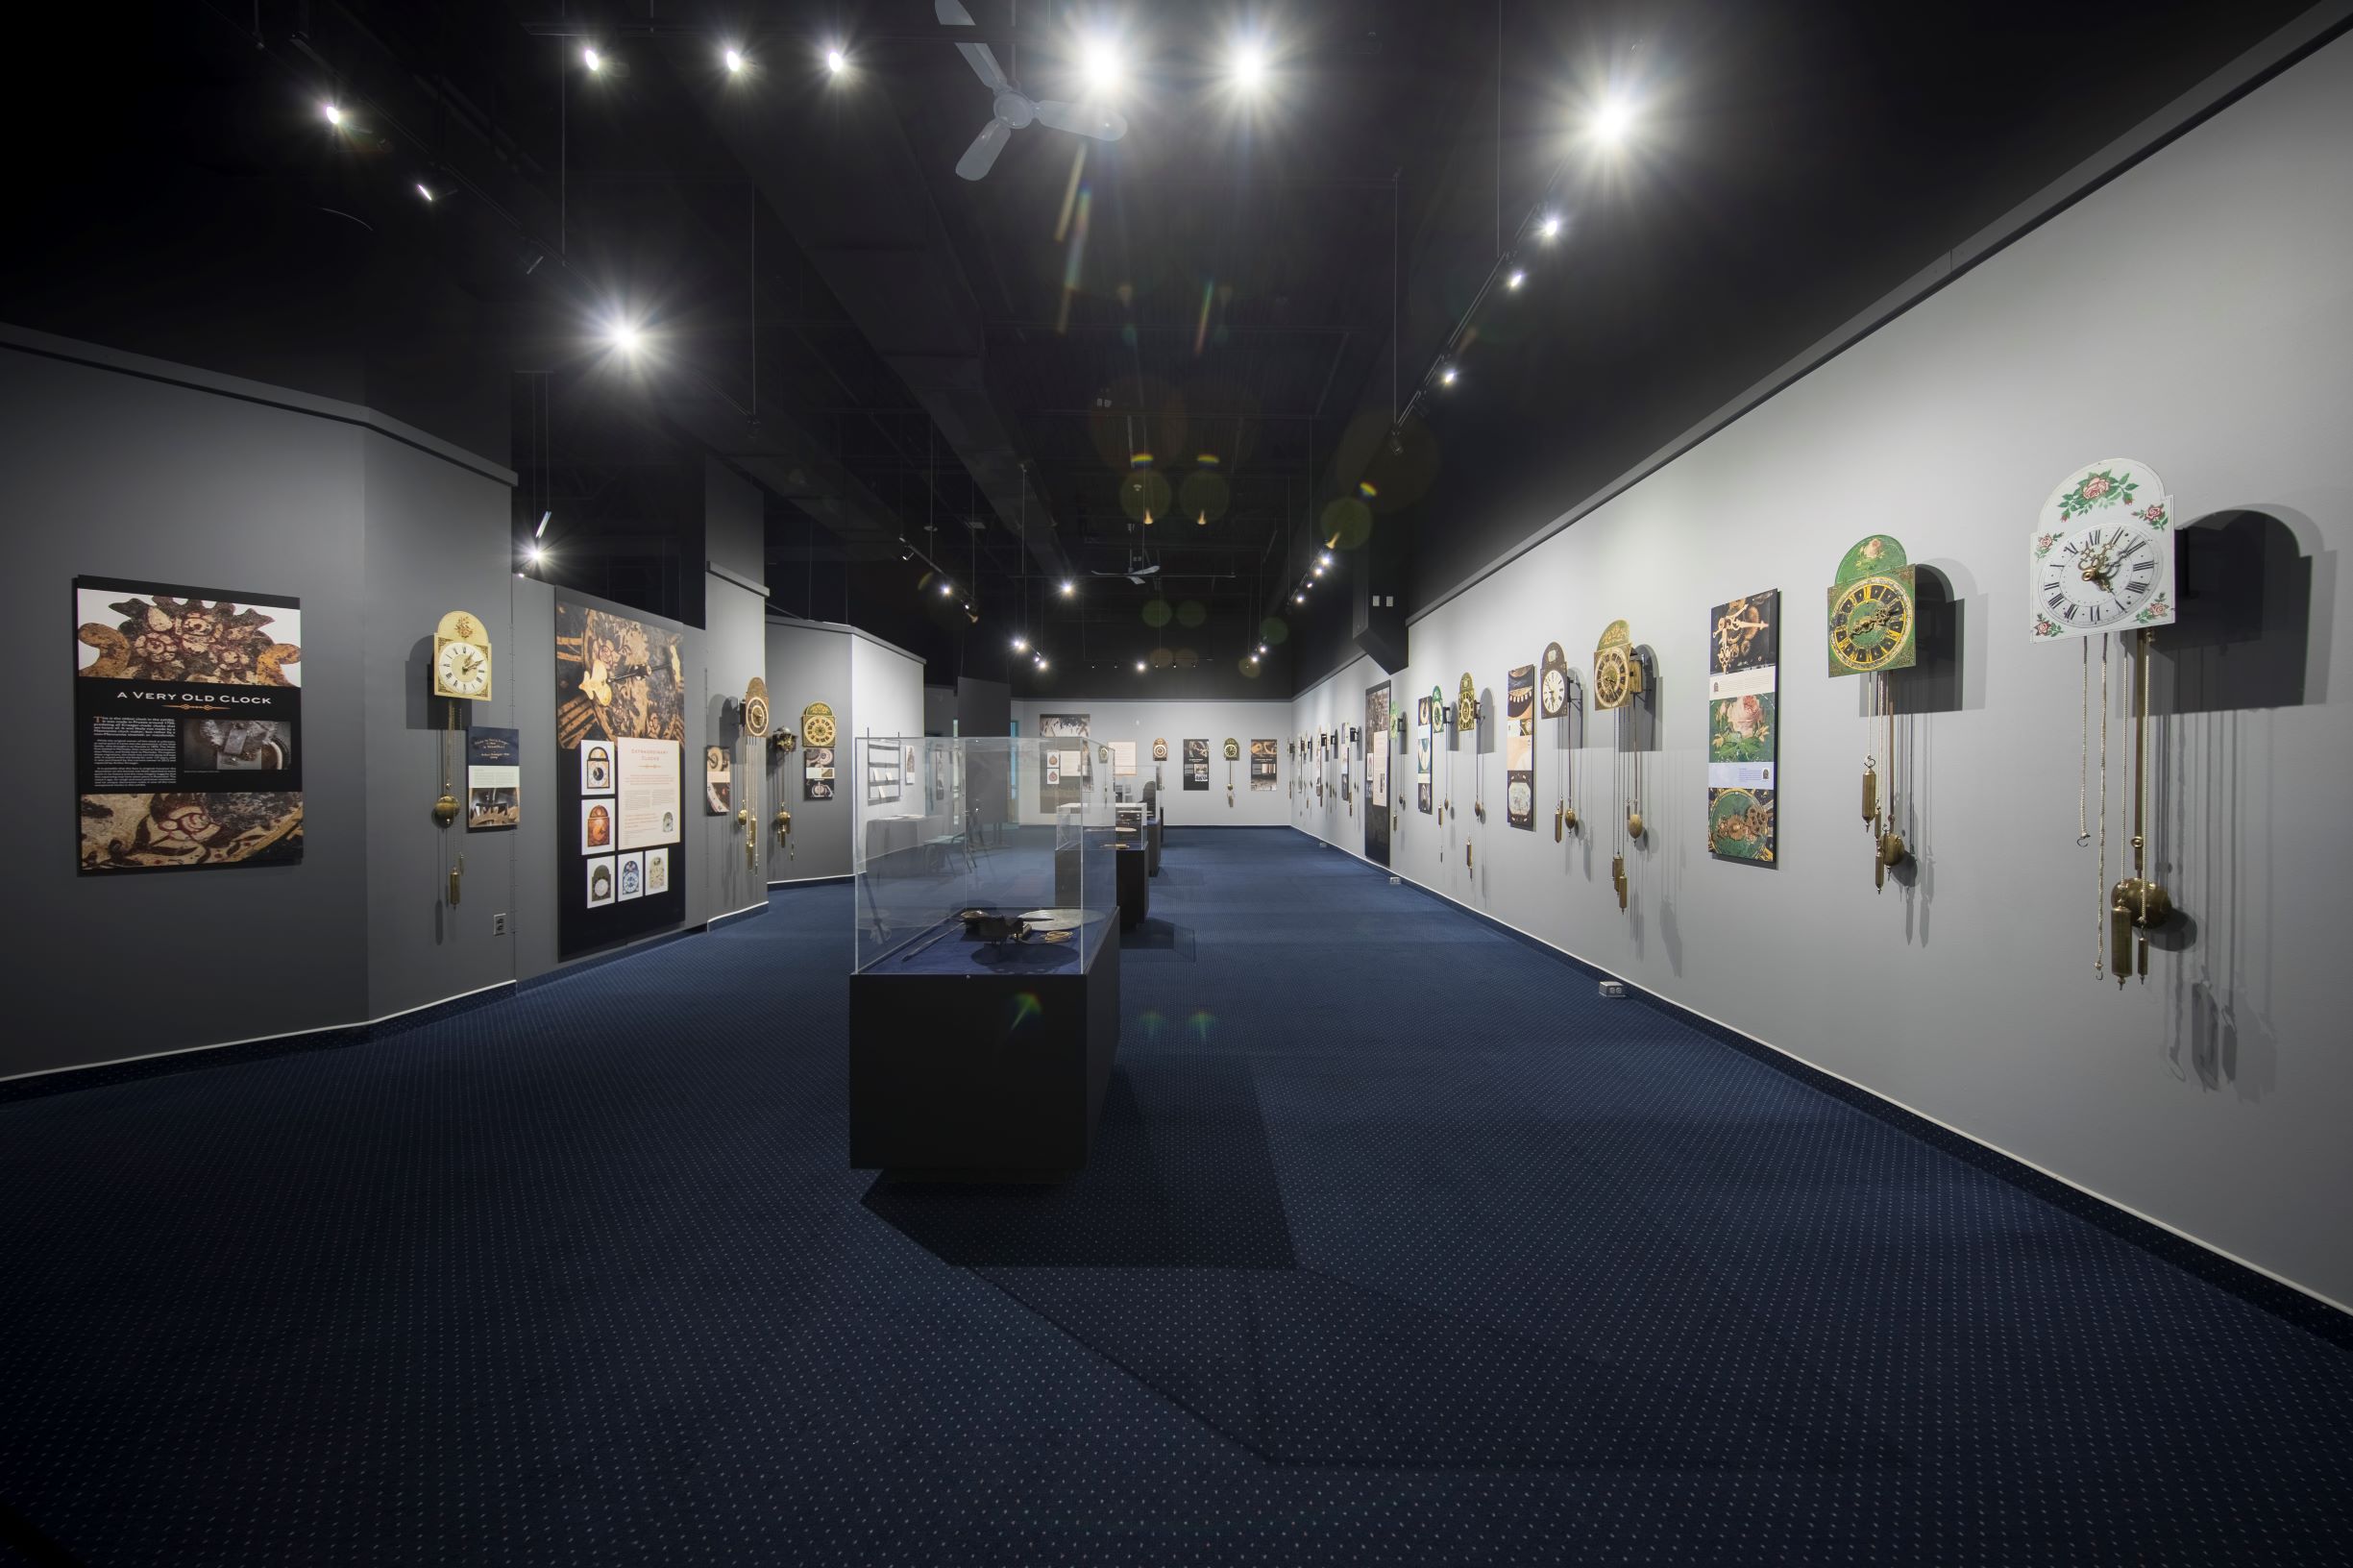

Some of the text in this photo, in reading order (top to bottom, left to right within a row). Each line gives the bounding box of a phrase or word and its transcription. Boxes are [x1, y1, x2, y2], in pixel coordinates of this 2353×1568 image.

[133, 691, 177, 700] VERY
[182, 693, 215, 702] OLD
[219, 695, 272, 704] CLOCK
